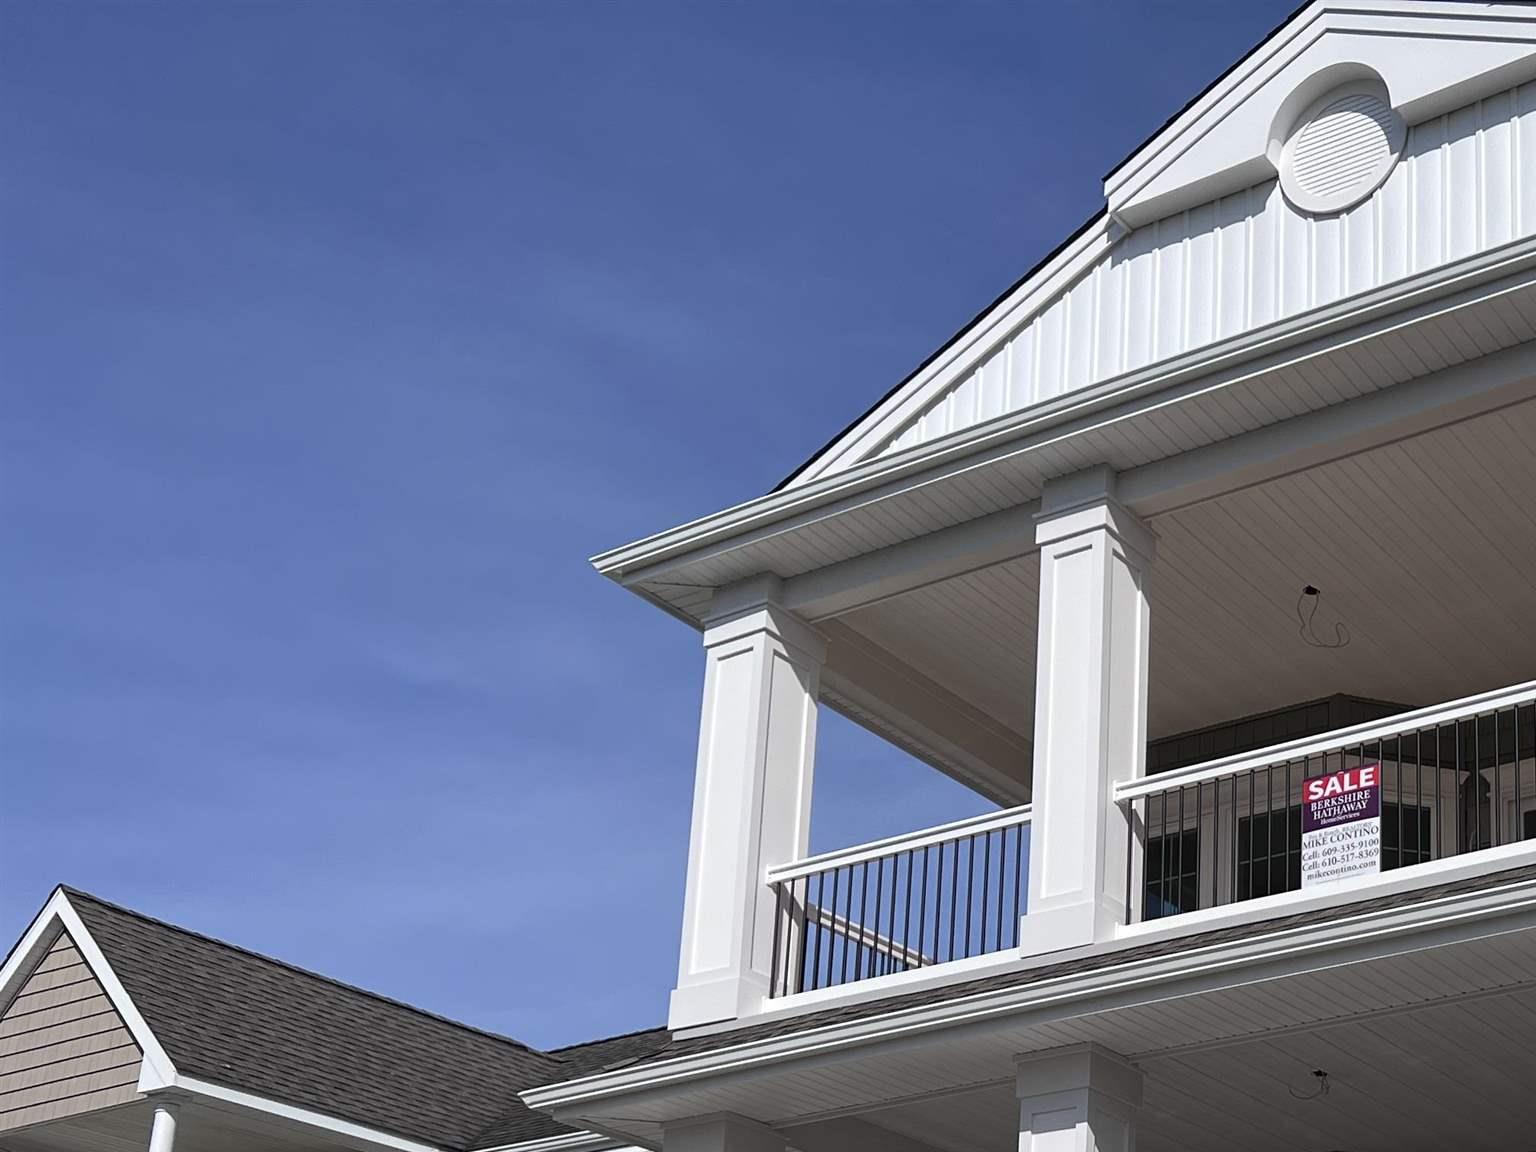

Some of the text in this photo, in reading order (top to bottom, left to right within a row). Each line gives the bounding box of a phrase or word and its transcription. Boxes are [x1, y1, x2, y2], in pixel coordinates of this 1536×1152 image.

[1308, 767, 1375, 800] SALE
[1311, 789, 1371, 812] BERKSHIRE
[1313, 800, 1368, 820] HATHAWAY
[1303, 837, 1329, 849] MIKE
[1330, 825, 1379, 843] CONTINO
[1302, 838, 1379, 862] Cell: 609-335-9100
[1302, 847, 1379, 872] Cell: 610-517-8369
[1307, 860, 1377, 880] mikecontino.com
